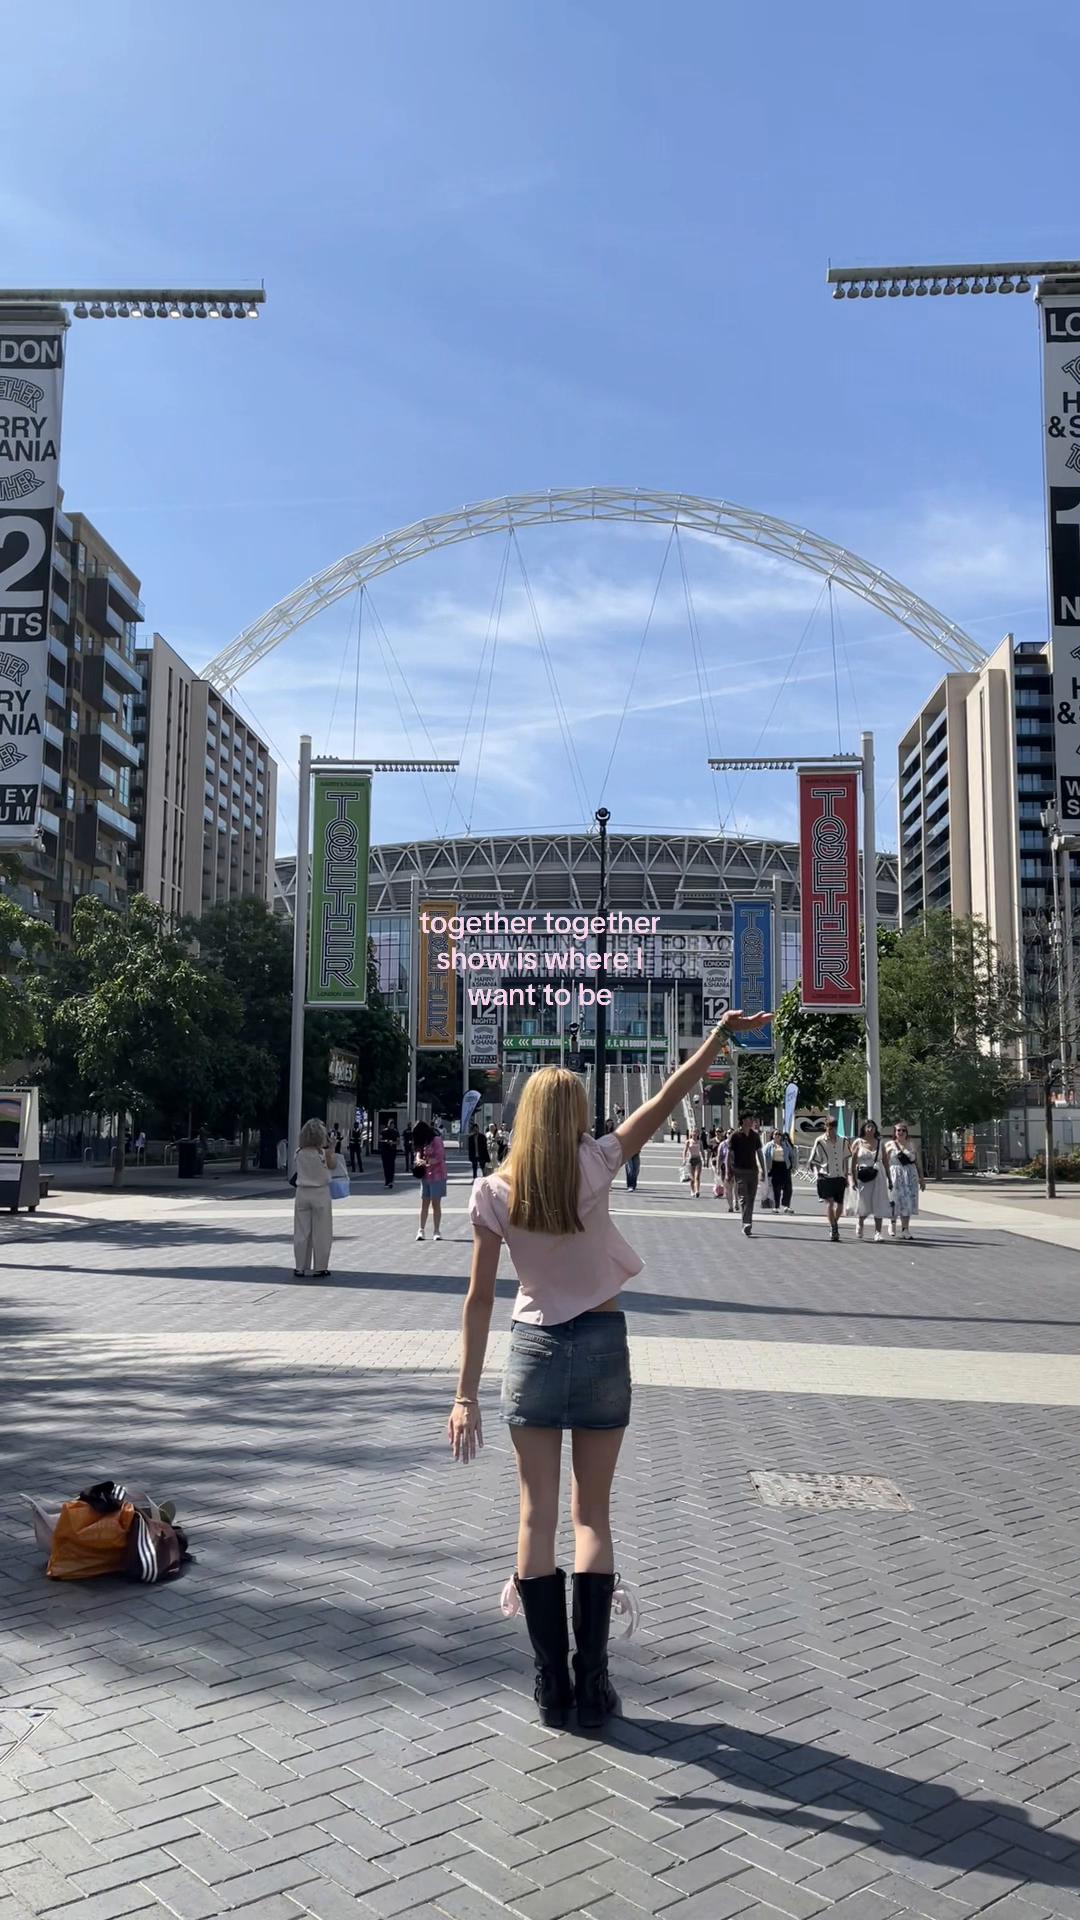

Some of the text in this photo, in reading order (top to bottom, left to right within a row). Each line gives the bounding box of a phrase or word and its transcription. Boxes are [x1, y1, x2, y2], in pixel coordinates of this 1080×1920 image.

[0, 340, 58, 363] DON
[0, 515, 46, 608] 2
[5, 788, 34, 803] EY
[320, 791, 359, 988] TOGETHER
[811, 787, 855, 991] TOGETHER
[661, 935, 700, 949] FOR
[705, 998, 729, 1019] 12
